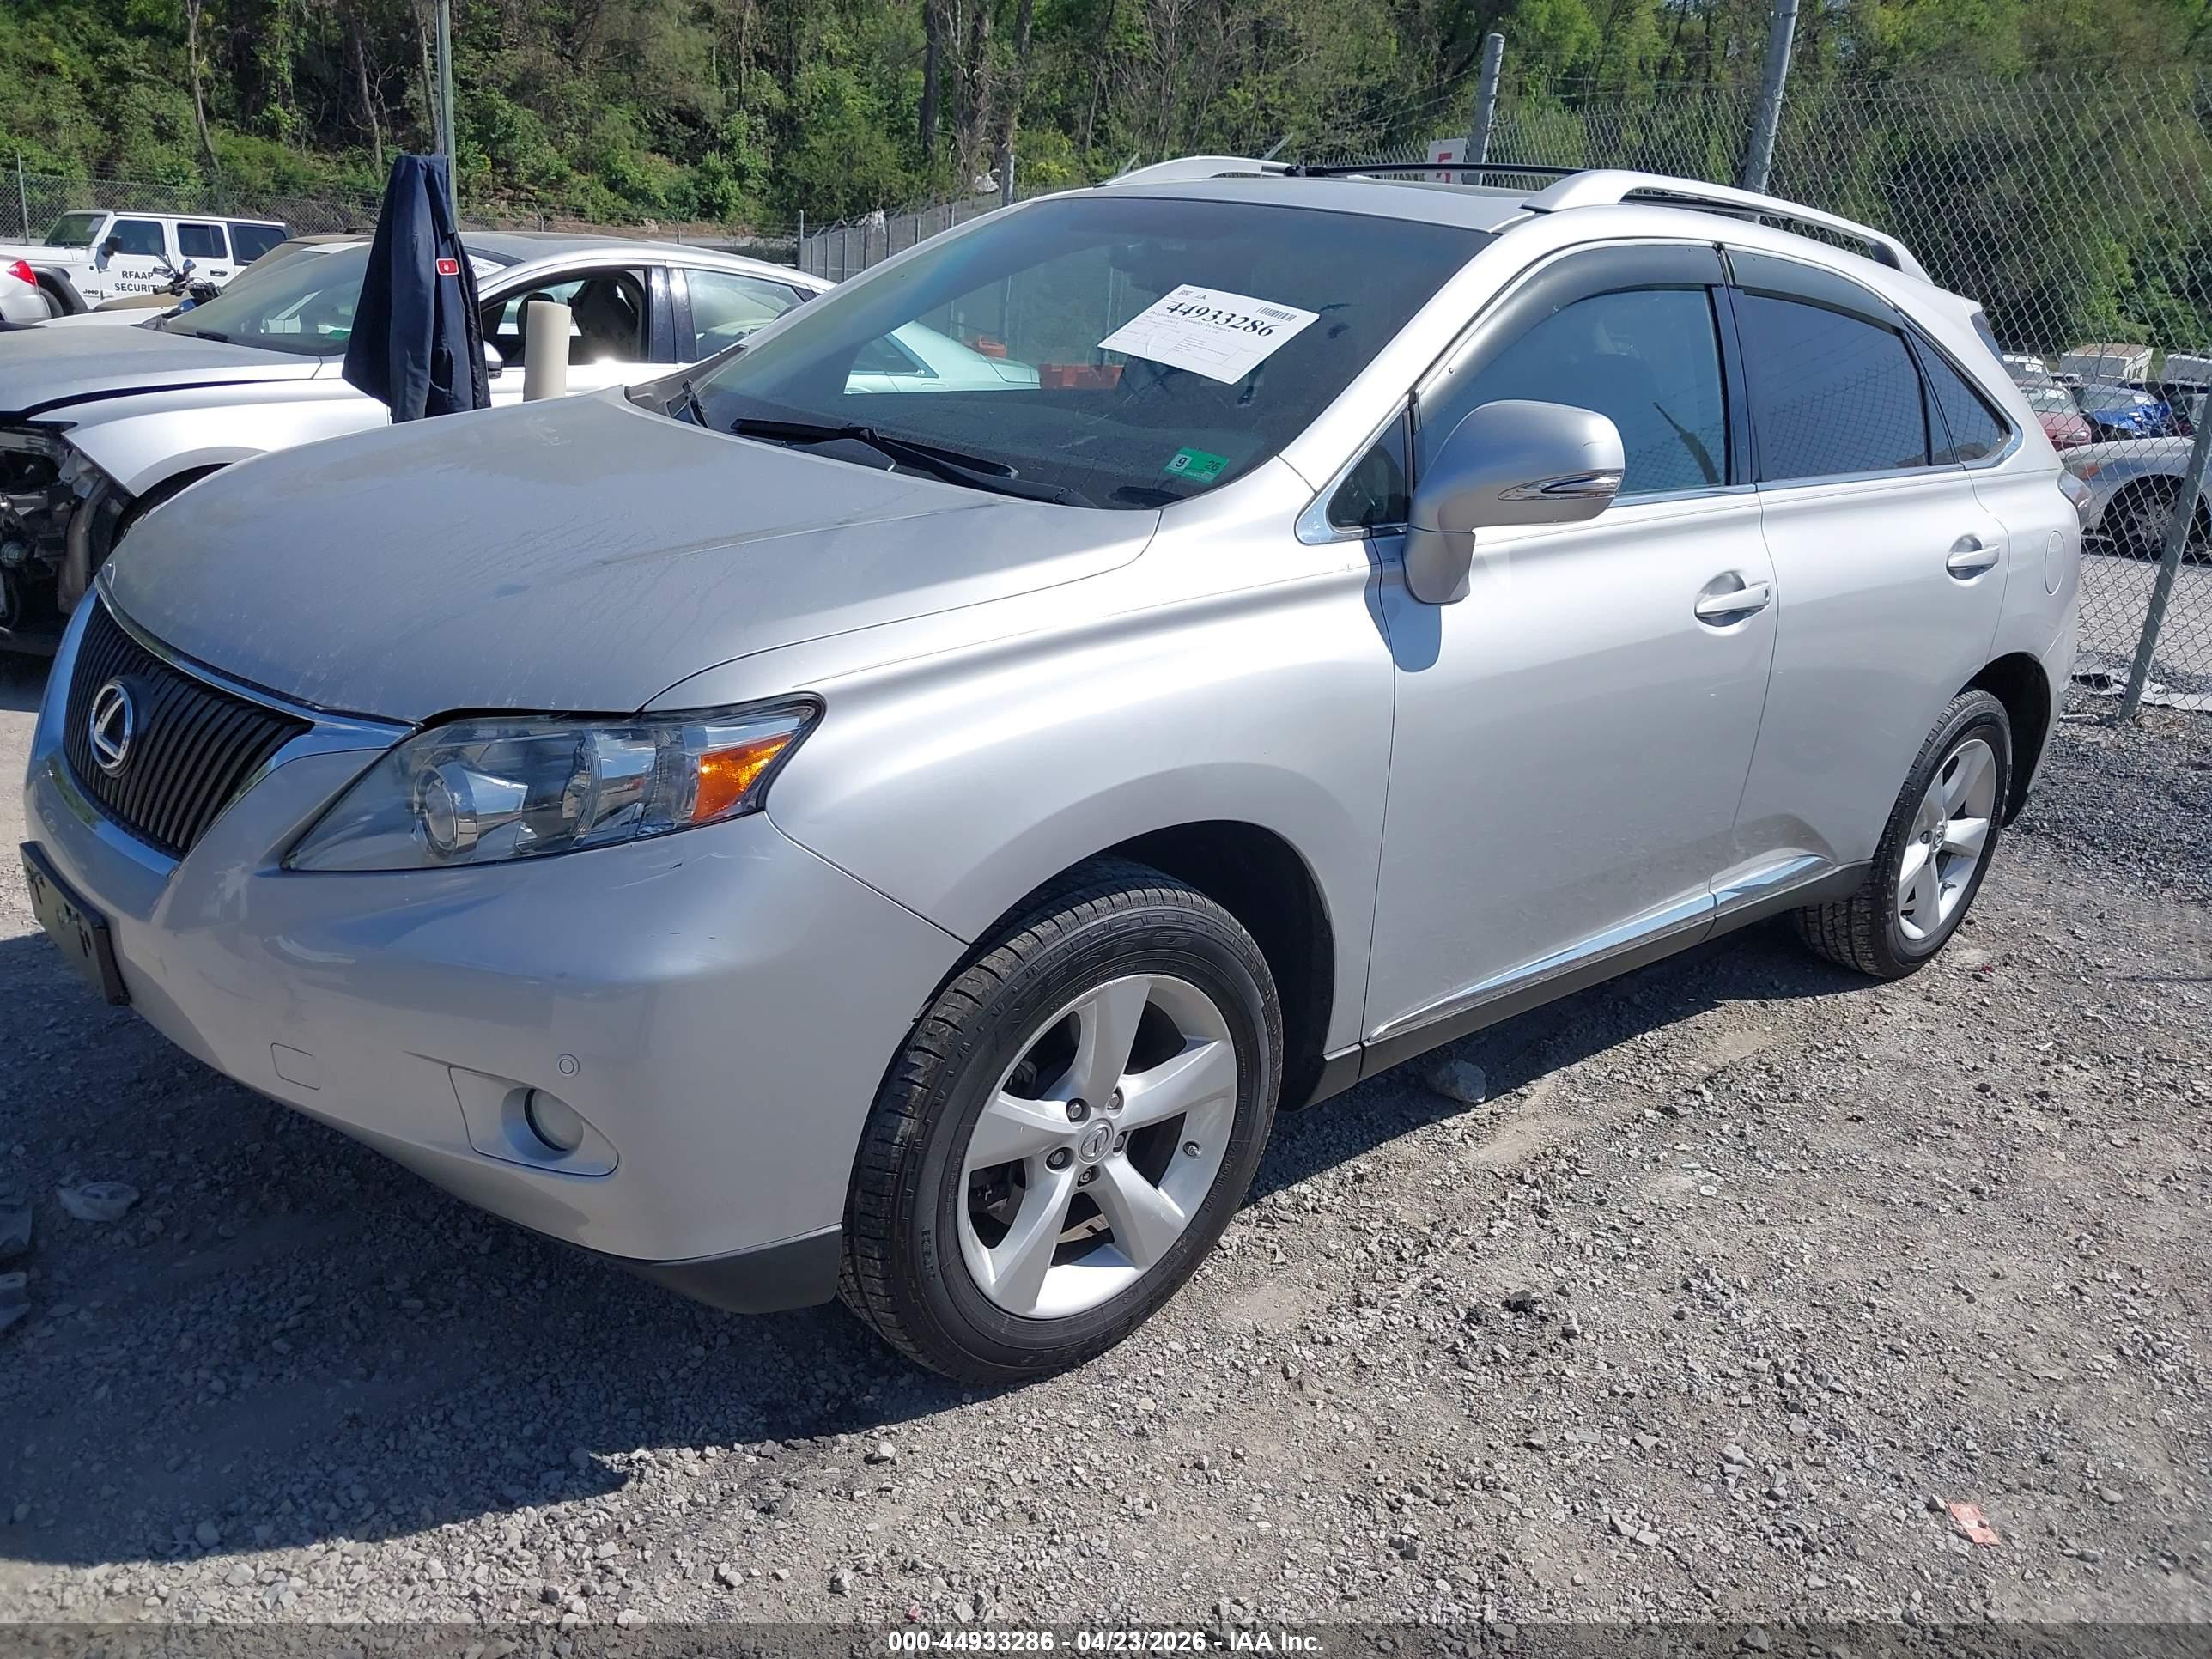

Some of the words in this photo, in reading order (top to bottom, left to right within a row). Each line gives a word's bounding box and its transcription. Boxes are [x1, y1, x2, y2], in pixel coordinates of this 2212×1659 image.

[122, 270, 154, 280] RFAAP
[1166, 302, 1279, 337] 44933286
[1175, 457, 1188, 467] 9
